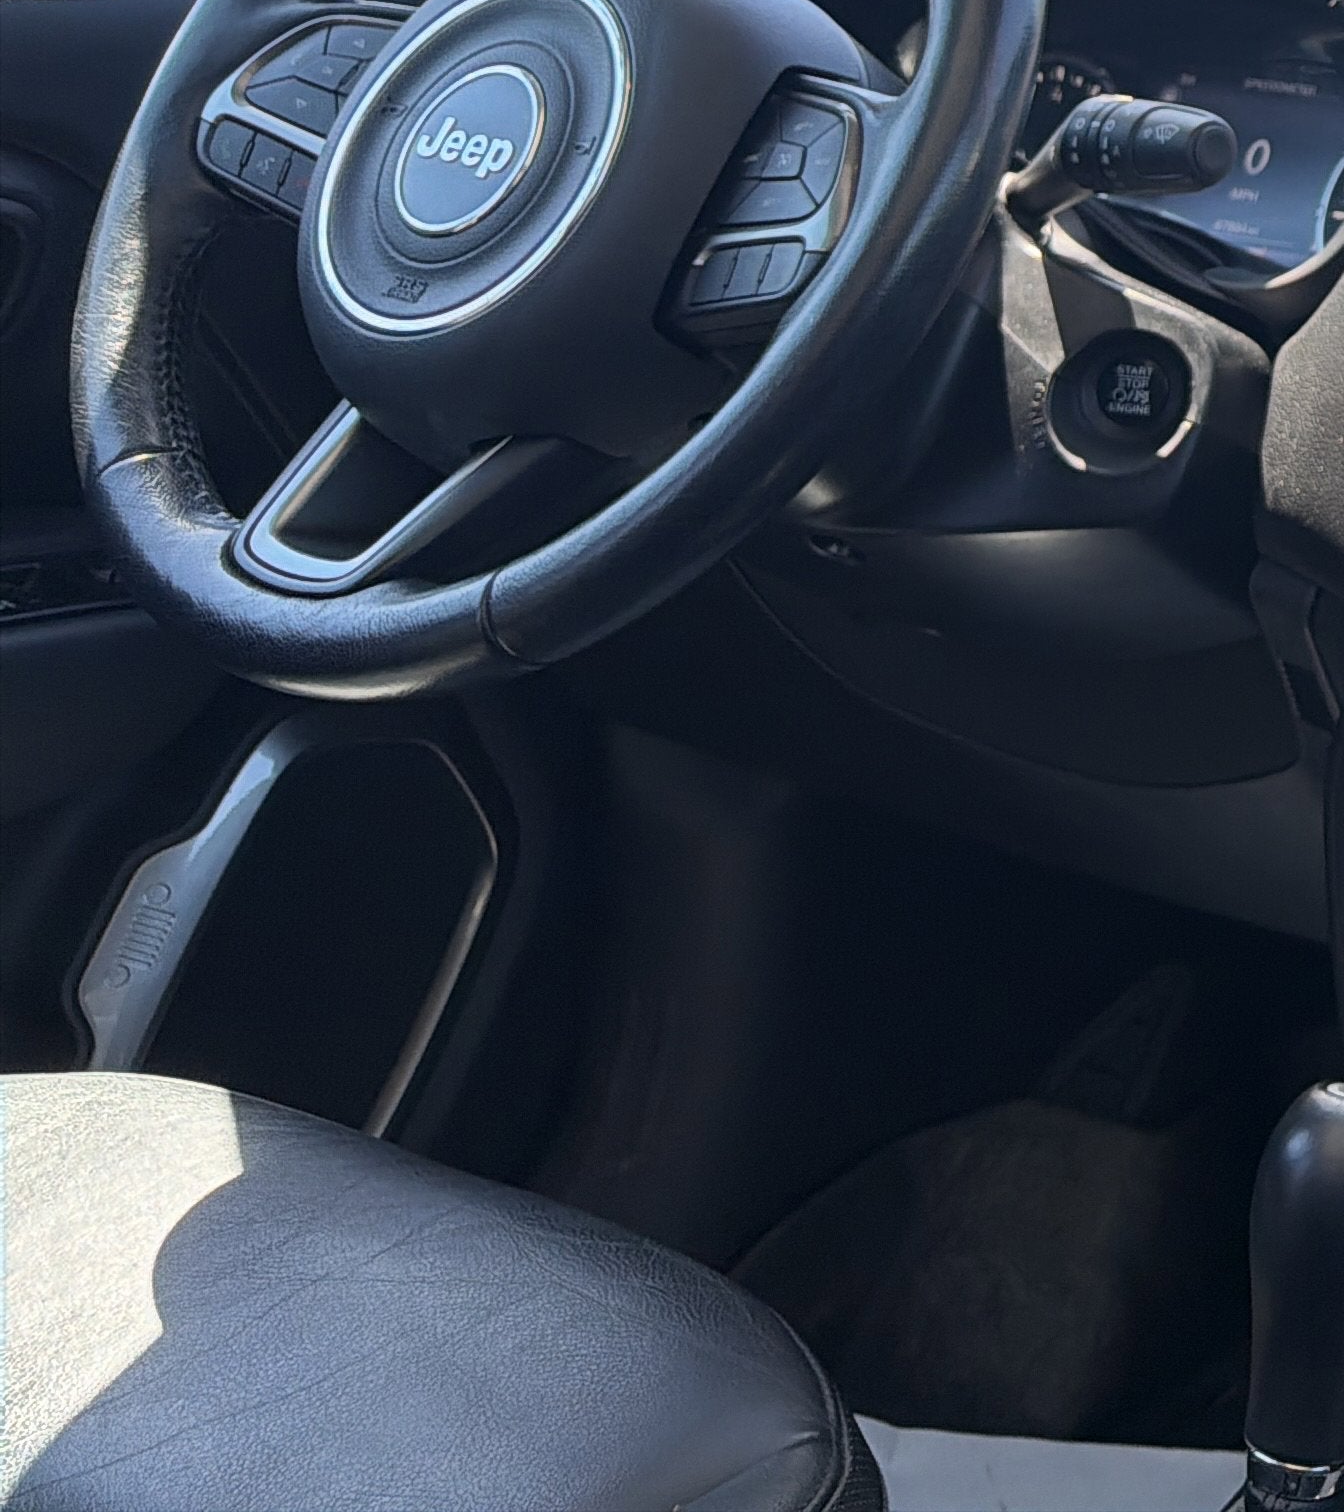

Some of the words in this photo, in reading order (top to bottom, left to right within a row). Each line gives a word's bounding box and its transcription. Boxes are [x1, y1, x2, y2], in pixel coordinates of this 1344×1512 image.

[416, 116, 514, 178] Jeep
[1244, 138, 1271, 176] 0
[1117, 364, 1153, 377] START
[1118, 377, 1149, 389] STOP
[1108, 403, 1150, 417] ENGINE
